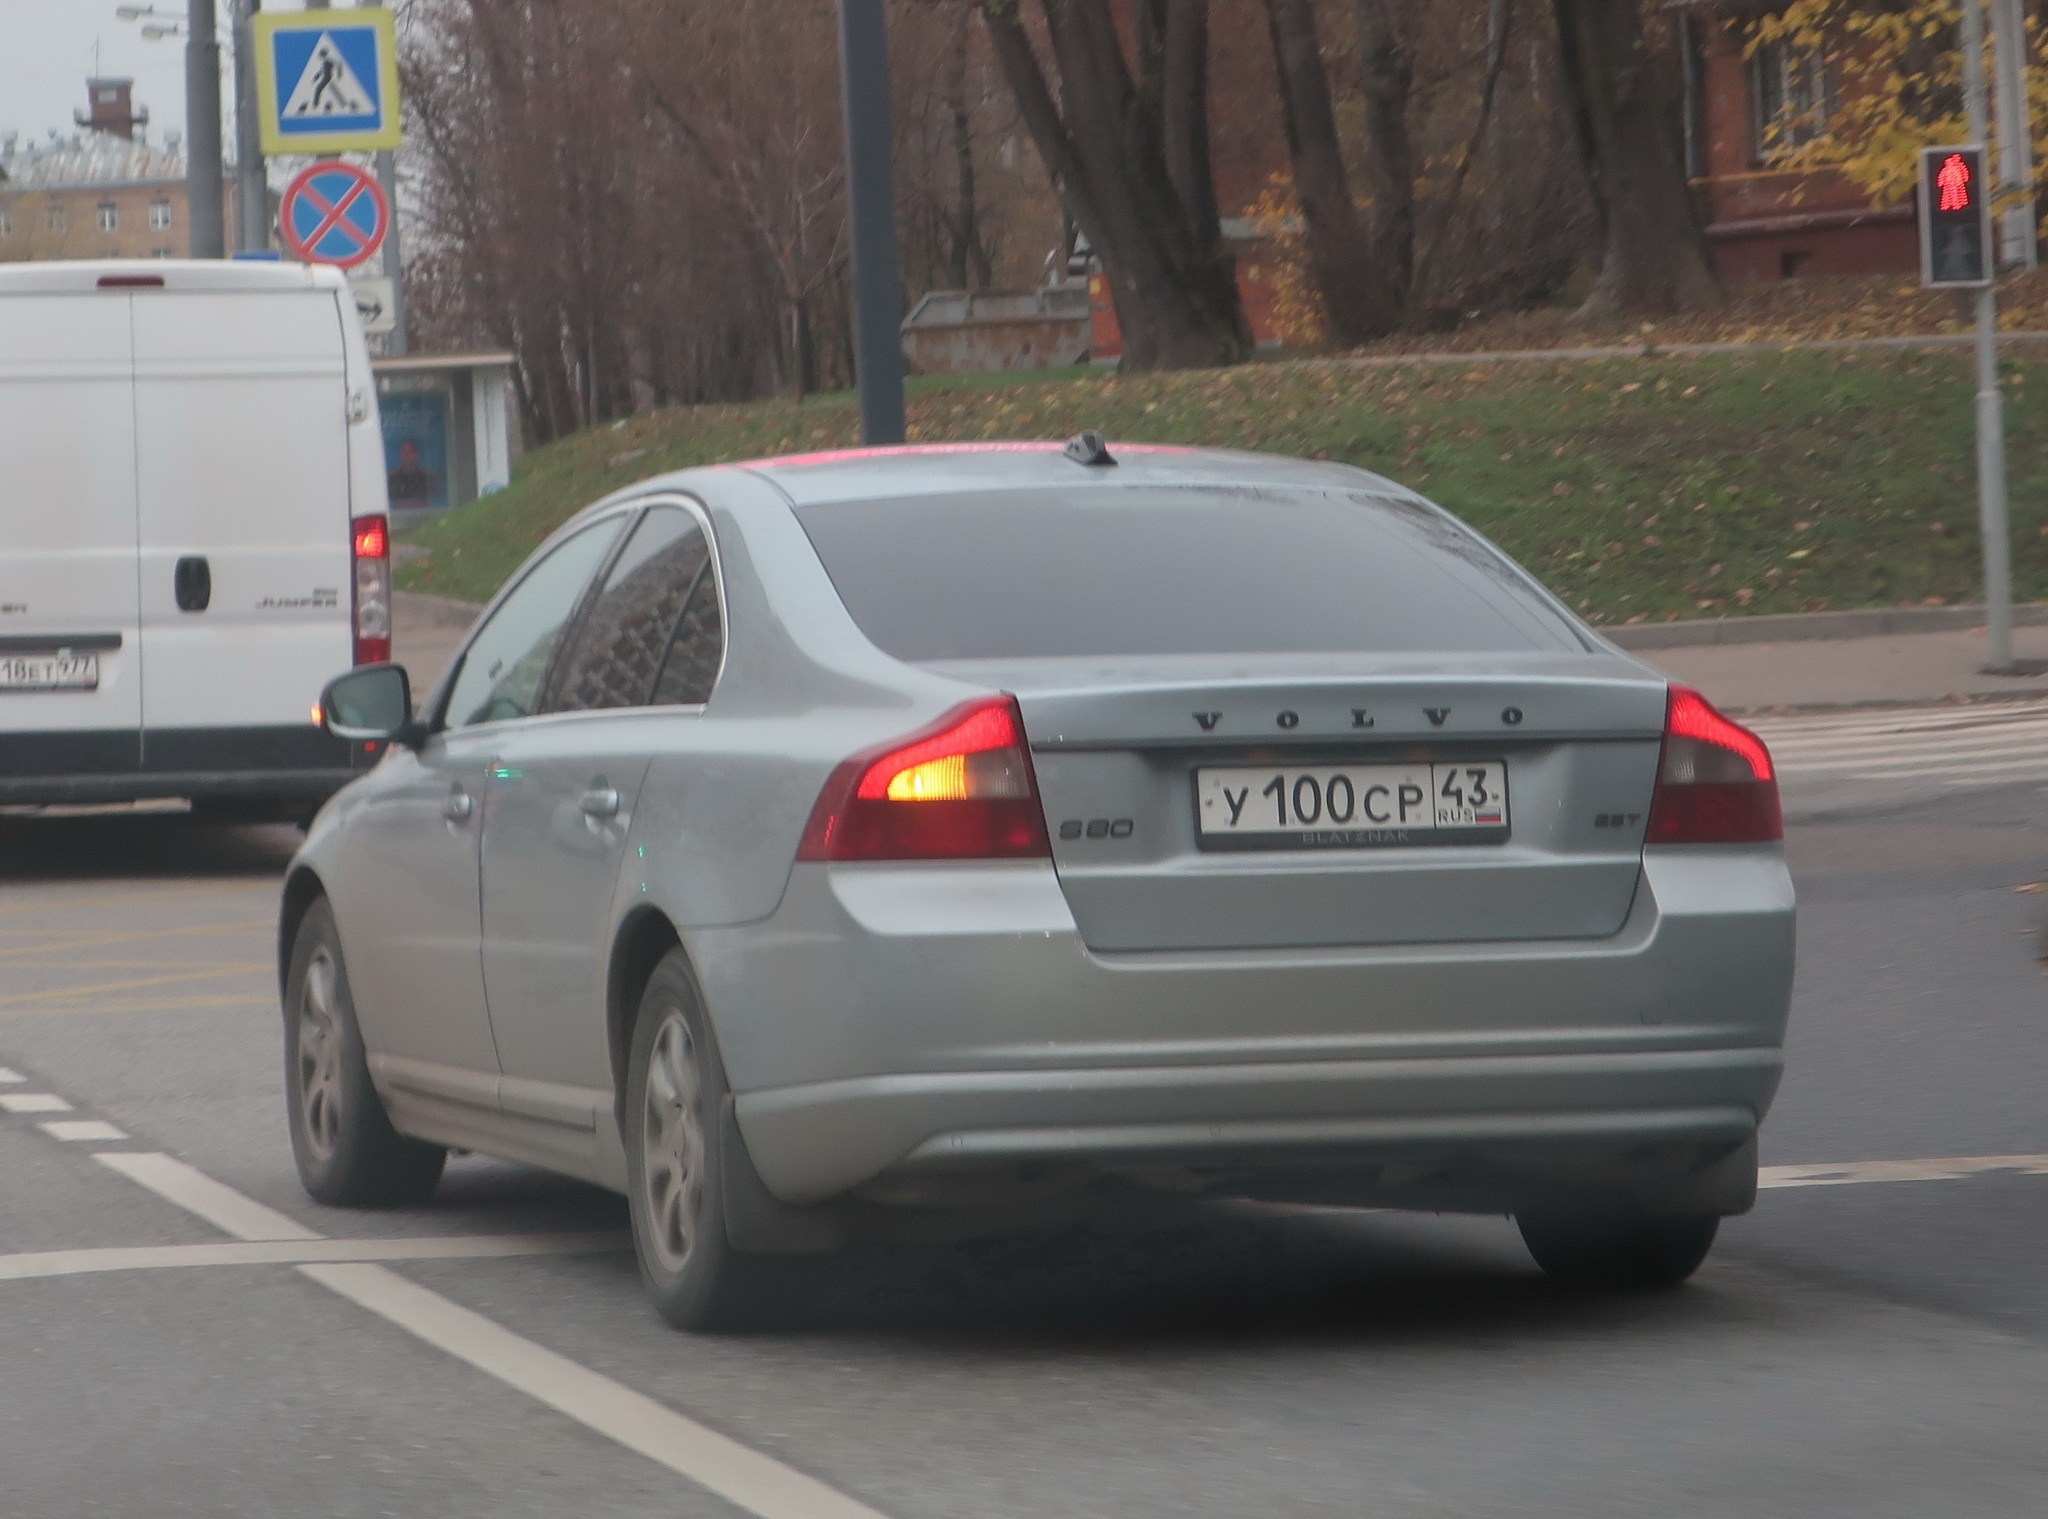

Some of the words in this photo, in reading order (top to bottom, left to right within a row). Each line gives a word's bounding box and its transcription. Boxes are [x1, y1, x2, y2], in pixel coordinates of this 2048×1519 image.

[1192, 706, 1524, 731] VOLVO
[1441, 768, 1489, 808] 43
[1437, 808, 1474, 825] RUS
